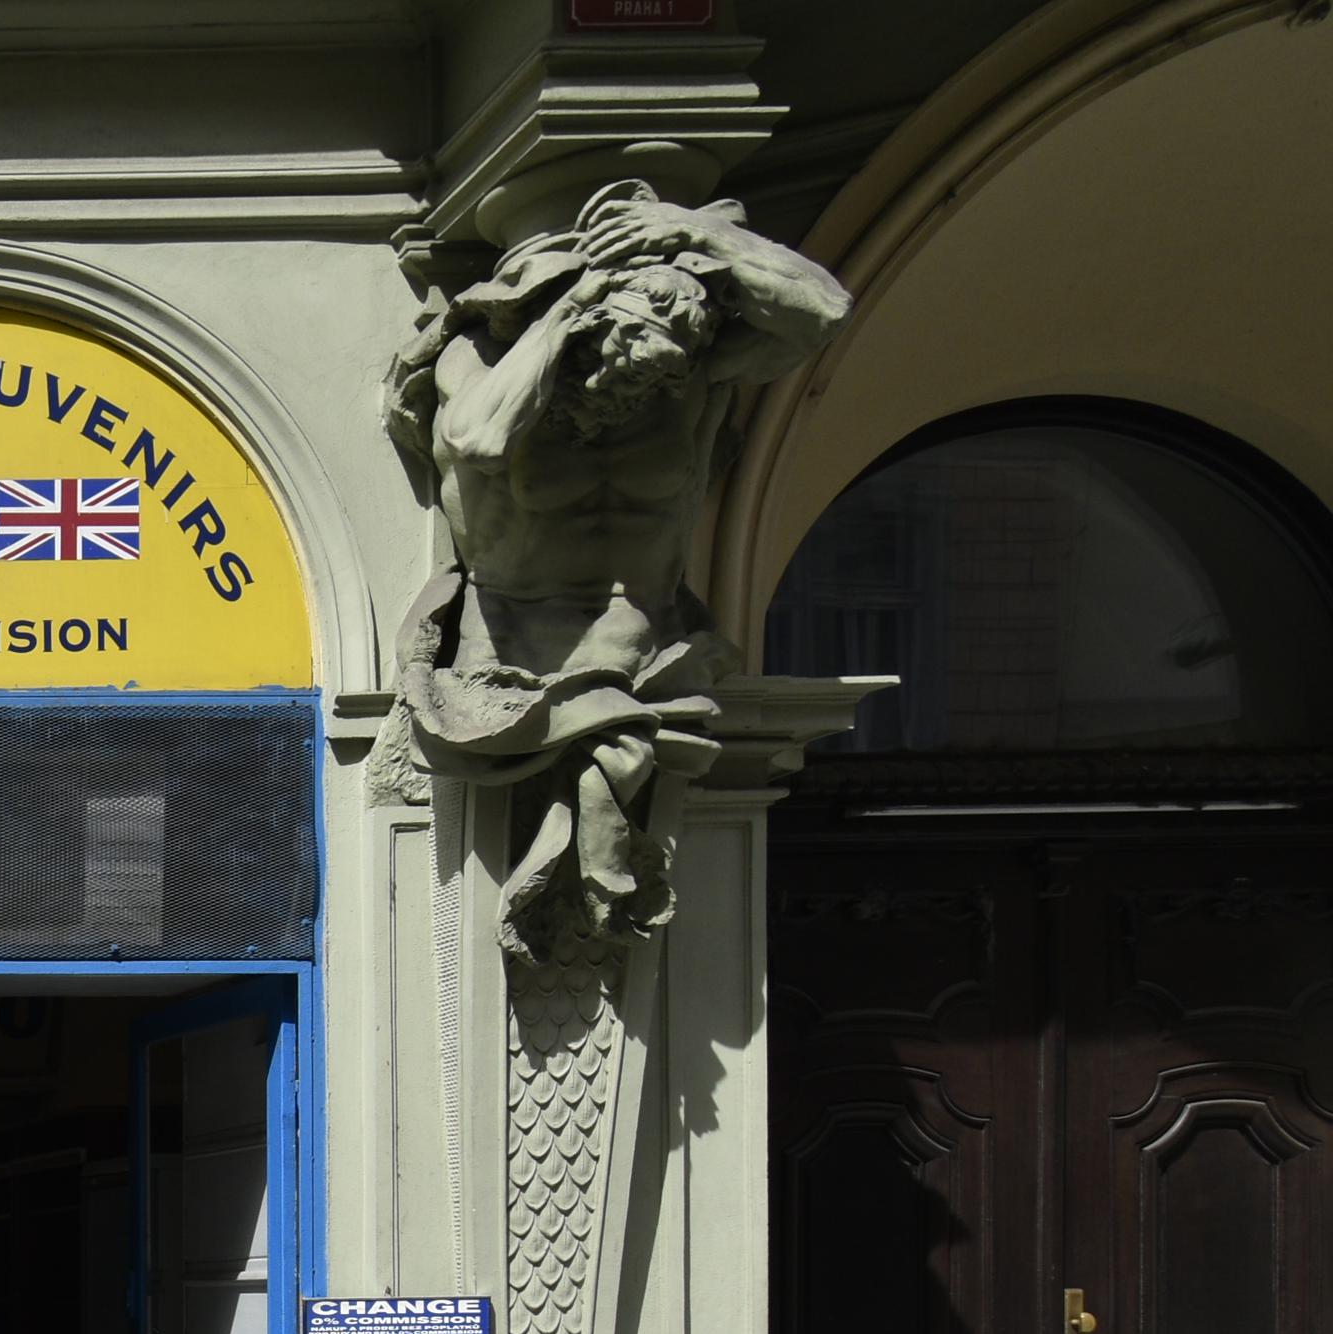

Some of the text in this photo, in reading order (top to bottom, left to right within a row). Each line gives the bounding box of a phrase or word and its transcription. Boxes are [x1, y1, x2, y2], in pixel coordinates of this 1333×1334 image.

[614, 1, 674, 16] PRAHA 1
[312, 1300, 481, 1315] CHANGE
[311, 1316, 481, 1325] 0% COMMISSION
